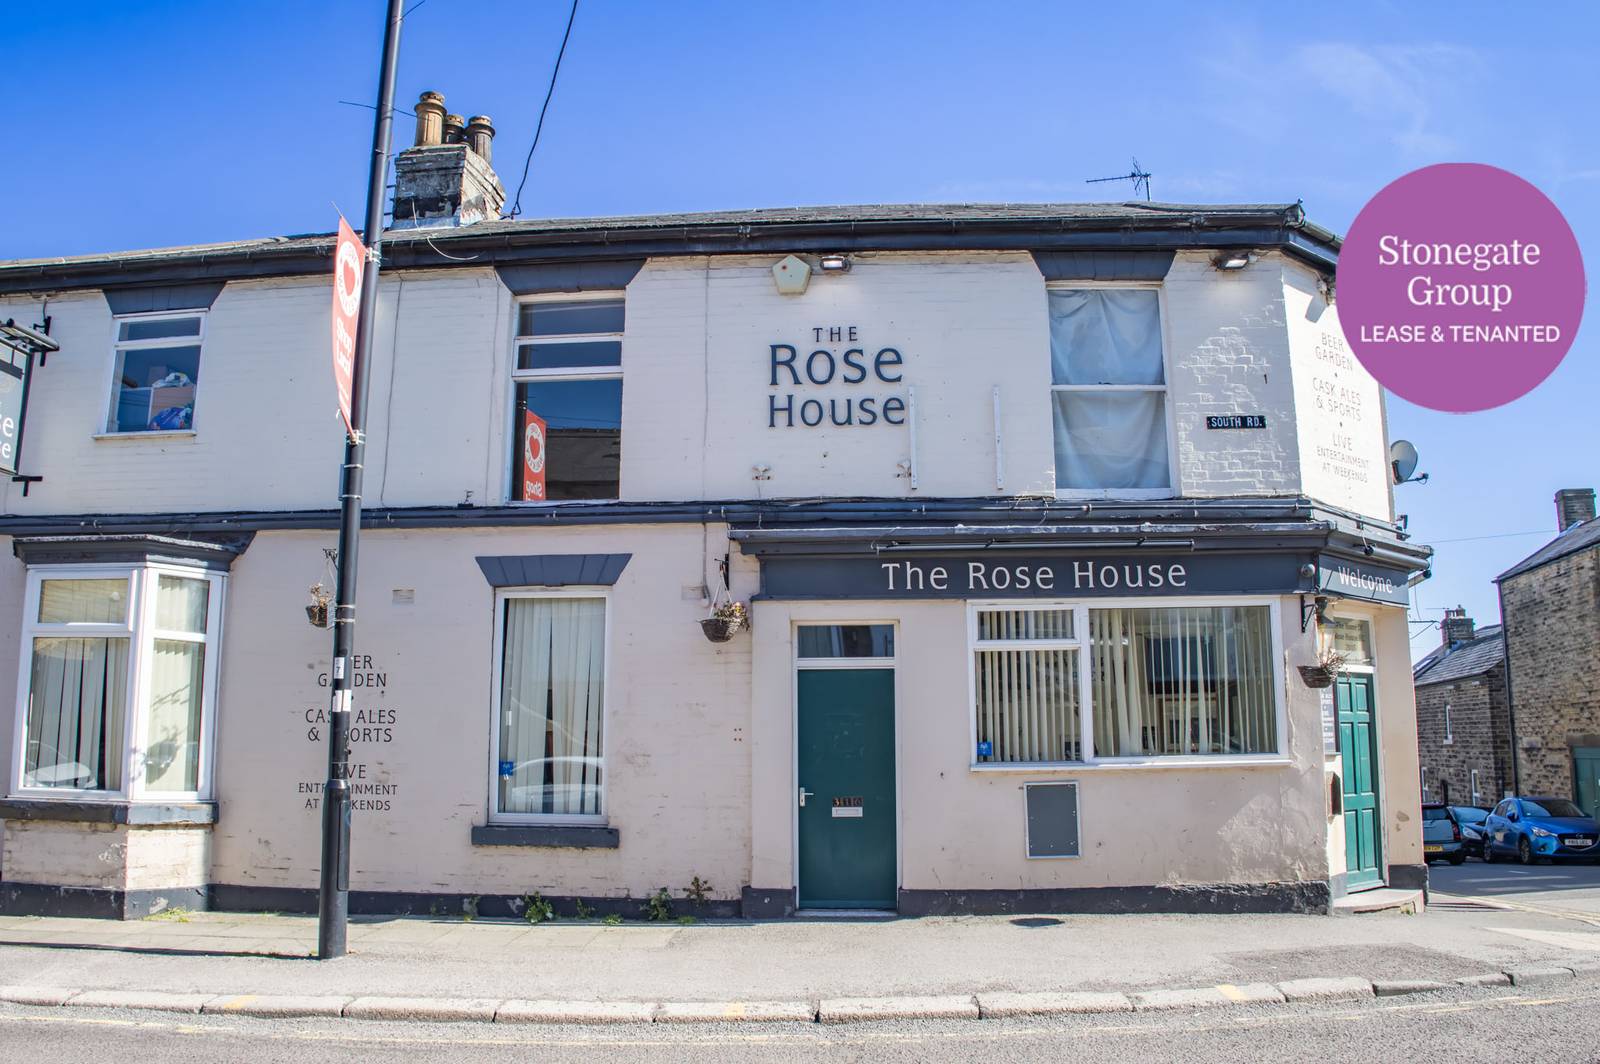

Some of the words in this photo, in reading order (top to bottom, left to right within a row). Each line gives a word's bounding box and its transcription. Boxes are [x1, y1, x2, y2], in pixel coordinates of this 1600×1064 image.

[813, 326, 859, 343] THE
[1321, 331, 1345, 353] BEER
[1315, 345, 1353, 372] GARDEN
[1312, 377, 1336, 397] CASK
[1340, 386, 1361, 406] ALES
[1328, 399, 1361, 421] SPORTS
[1211, 417, 1242, 428] SOUTH
[1246, 416, 1263, 427] RD.
[1332, 432, 1353, 452] LIVE
[881, 561, 948, 590] The
[967, 562, 1054, 589] Rose
[1073, 561, 1186, 588] House
[1337, 566, 1393, 593] Welcome
[353, 655, 373, 669] ER
[317, 673, 387, 687] GDEN
[305, 708, 332, 723] CA
[355, 709, 396, 724] ALES
[307, 726, 321, 742] &
[349, 727, 393, 743] ORTS
[347, 764, 367, 779] VE
[298, 782, 398, 795] ENTINMENT
[304, 798, 319, 809] AT
[351, 800, 391, 811] KENDS
